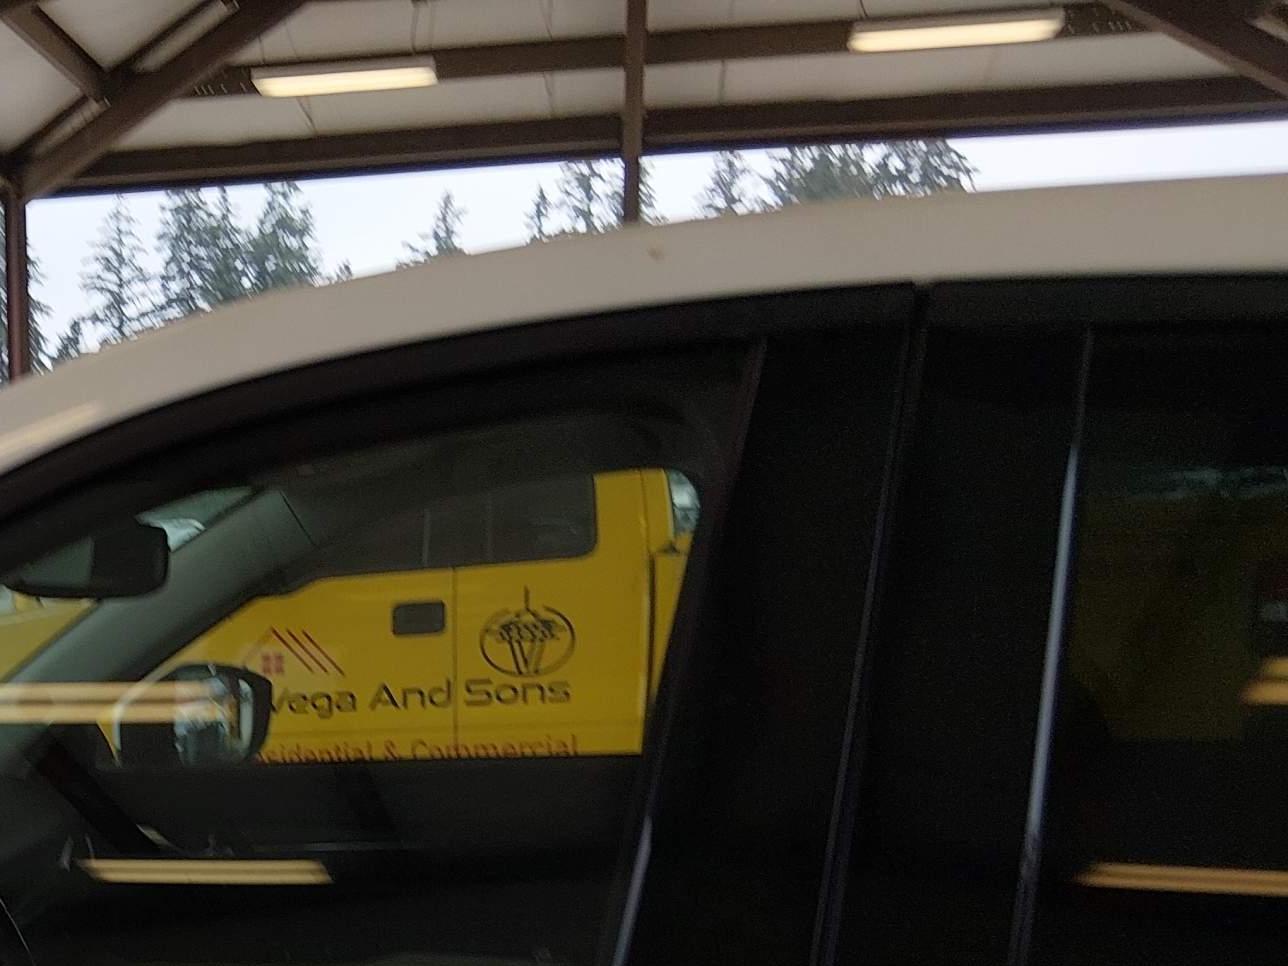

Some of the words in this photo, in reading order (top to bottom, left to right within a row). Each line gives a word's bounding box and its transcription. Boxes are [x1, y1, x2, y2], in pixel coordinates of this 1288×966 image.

[271, 688, 357, 720] Vega
[368, 677, 452, 710] And
[464, 677, 571, 707] Sons
[383, 739, 401, 761] &
